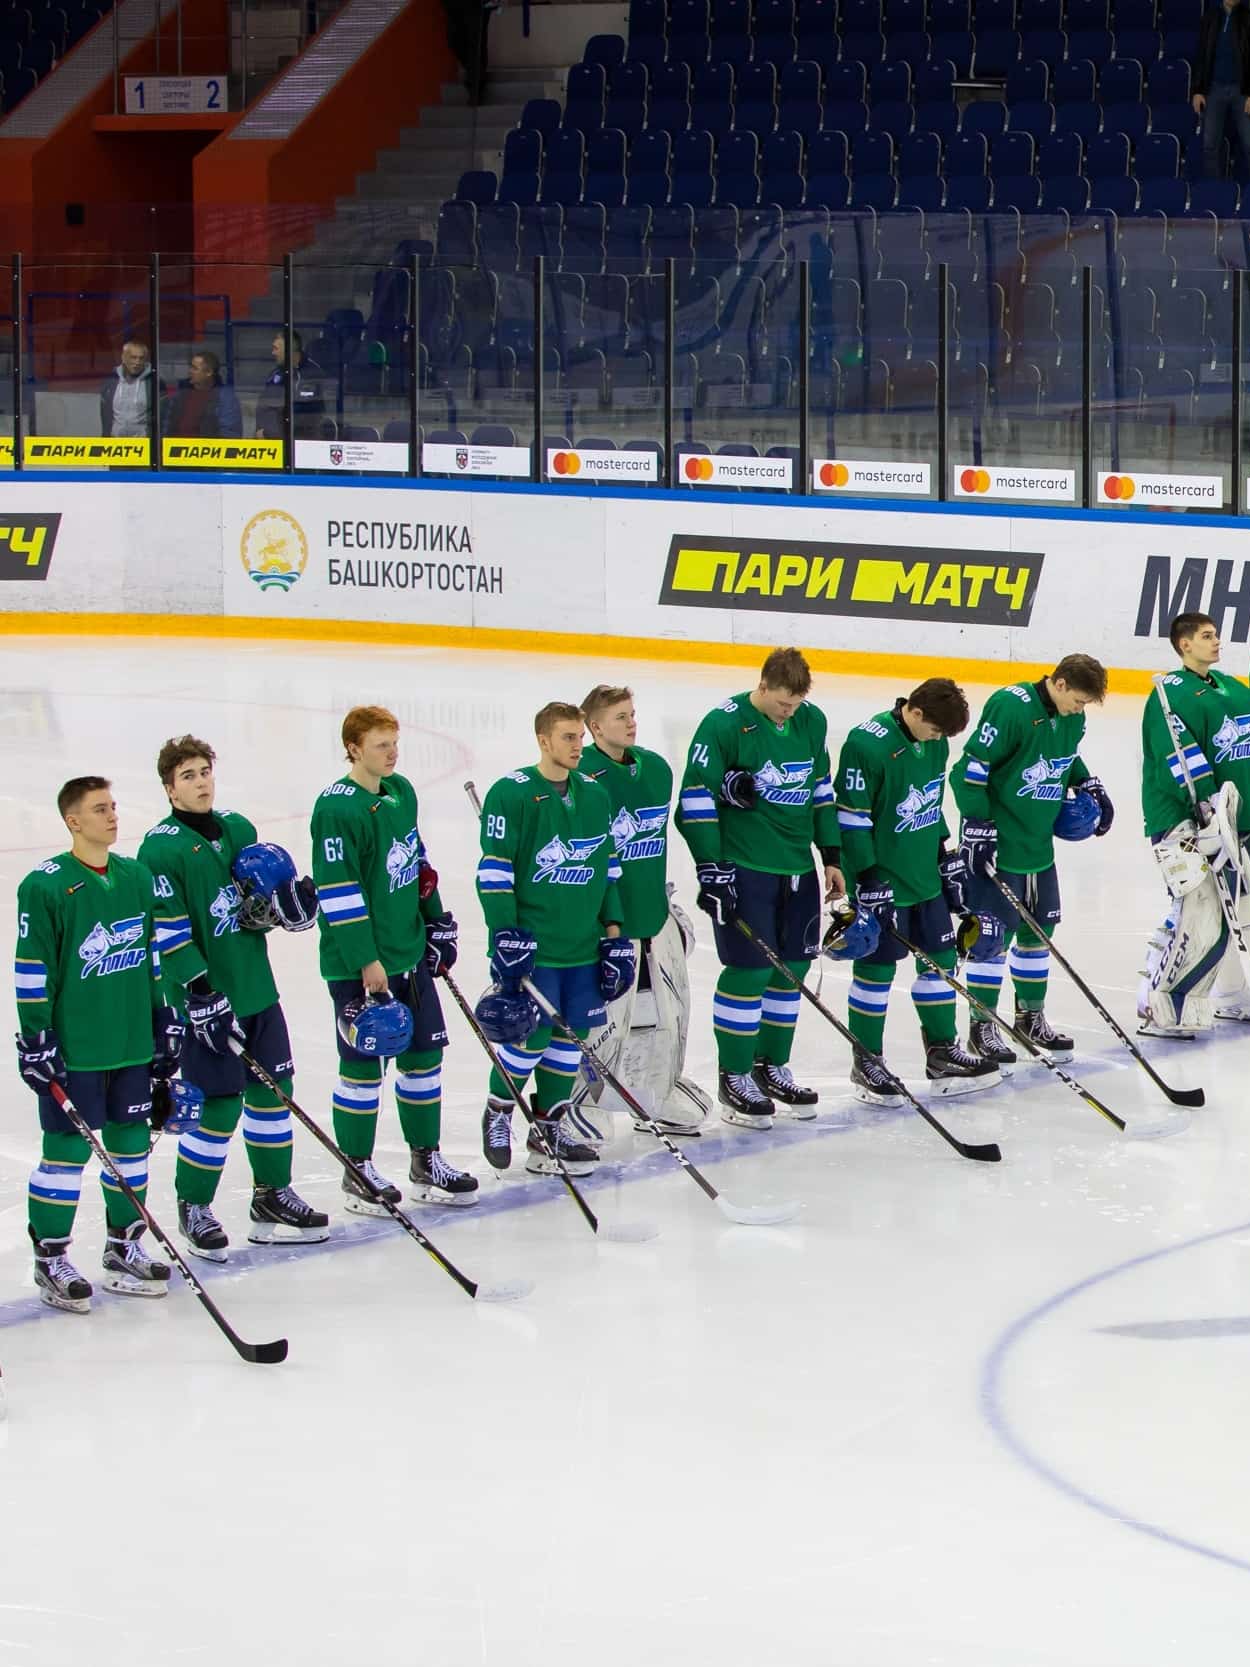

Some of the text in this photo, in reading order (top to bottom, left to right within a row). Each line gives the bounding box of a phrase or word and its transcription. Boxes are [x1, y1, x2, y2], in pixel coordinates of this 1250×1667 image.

[134, 80, 145, 109] 1
[206, 80, 221, 109] 2
[31, 445, 144, 458] ПАРИ МАТЧ
[169, 446, 277, 460] ПАРИ МАТЧ
[586, 457, 650, 472] mastercard
[718, 463, 785, 479] mastercard
[854, 469, 923, 484] mastercard
[996, 475, 1068, 490] mastercard
[1140, 482, 1215, 497] mastercard
[327, 520, 473, 553] РЕСПУБЛИКА
[328, 559, 503, 594] БАШКОРТОСТАН
[671, 549, 1031, 610] ПАРИ МАТЧ
[691, 743, 710, 768] 74
[845, 768, 866, 791] 56
[323, 836, 344, 863] 63
[1215, 870, 1248, 952] CCM
[1166, 932, 1190, 985] CCM
[645, 1119, 690, 1166] CCM
